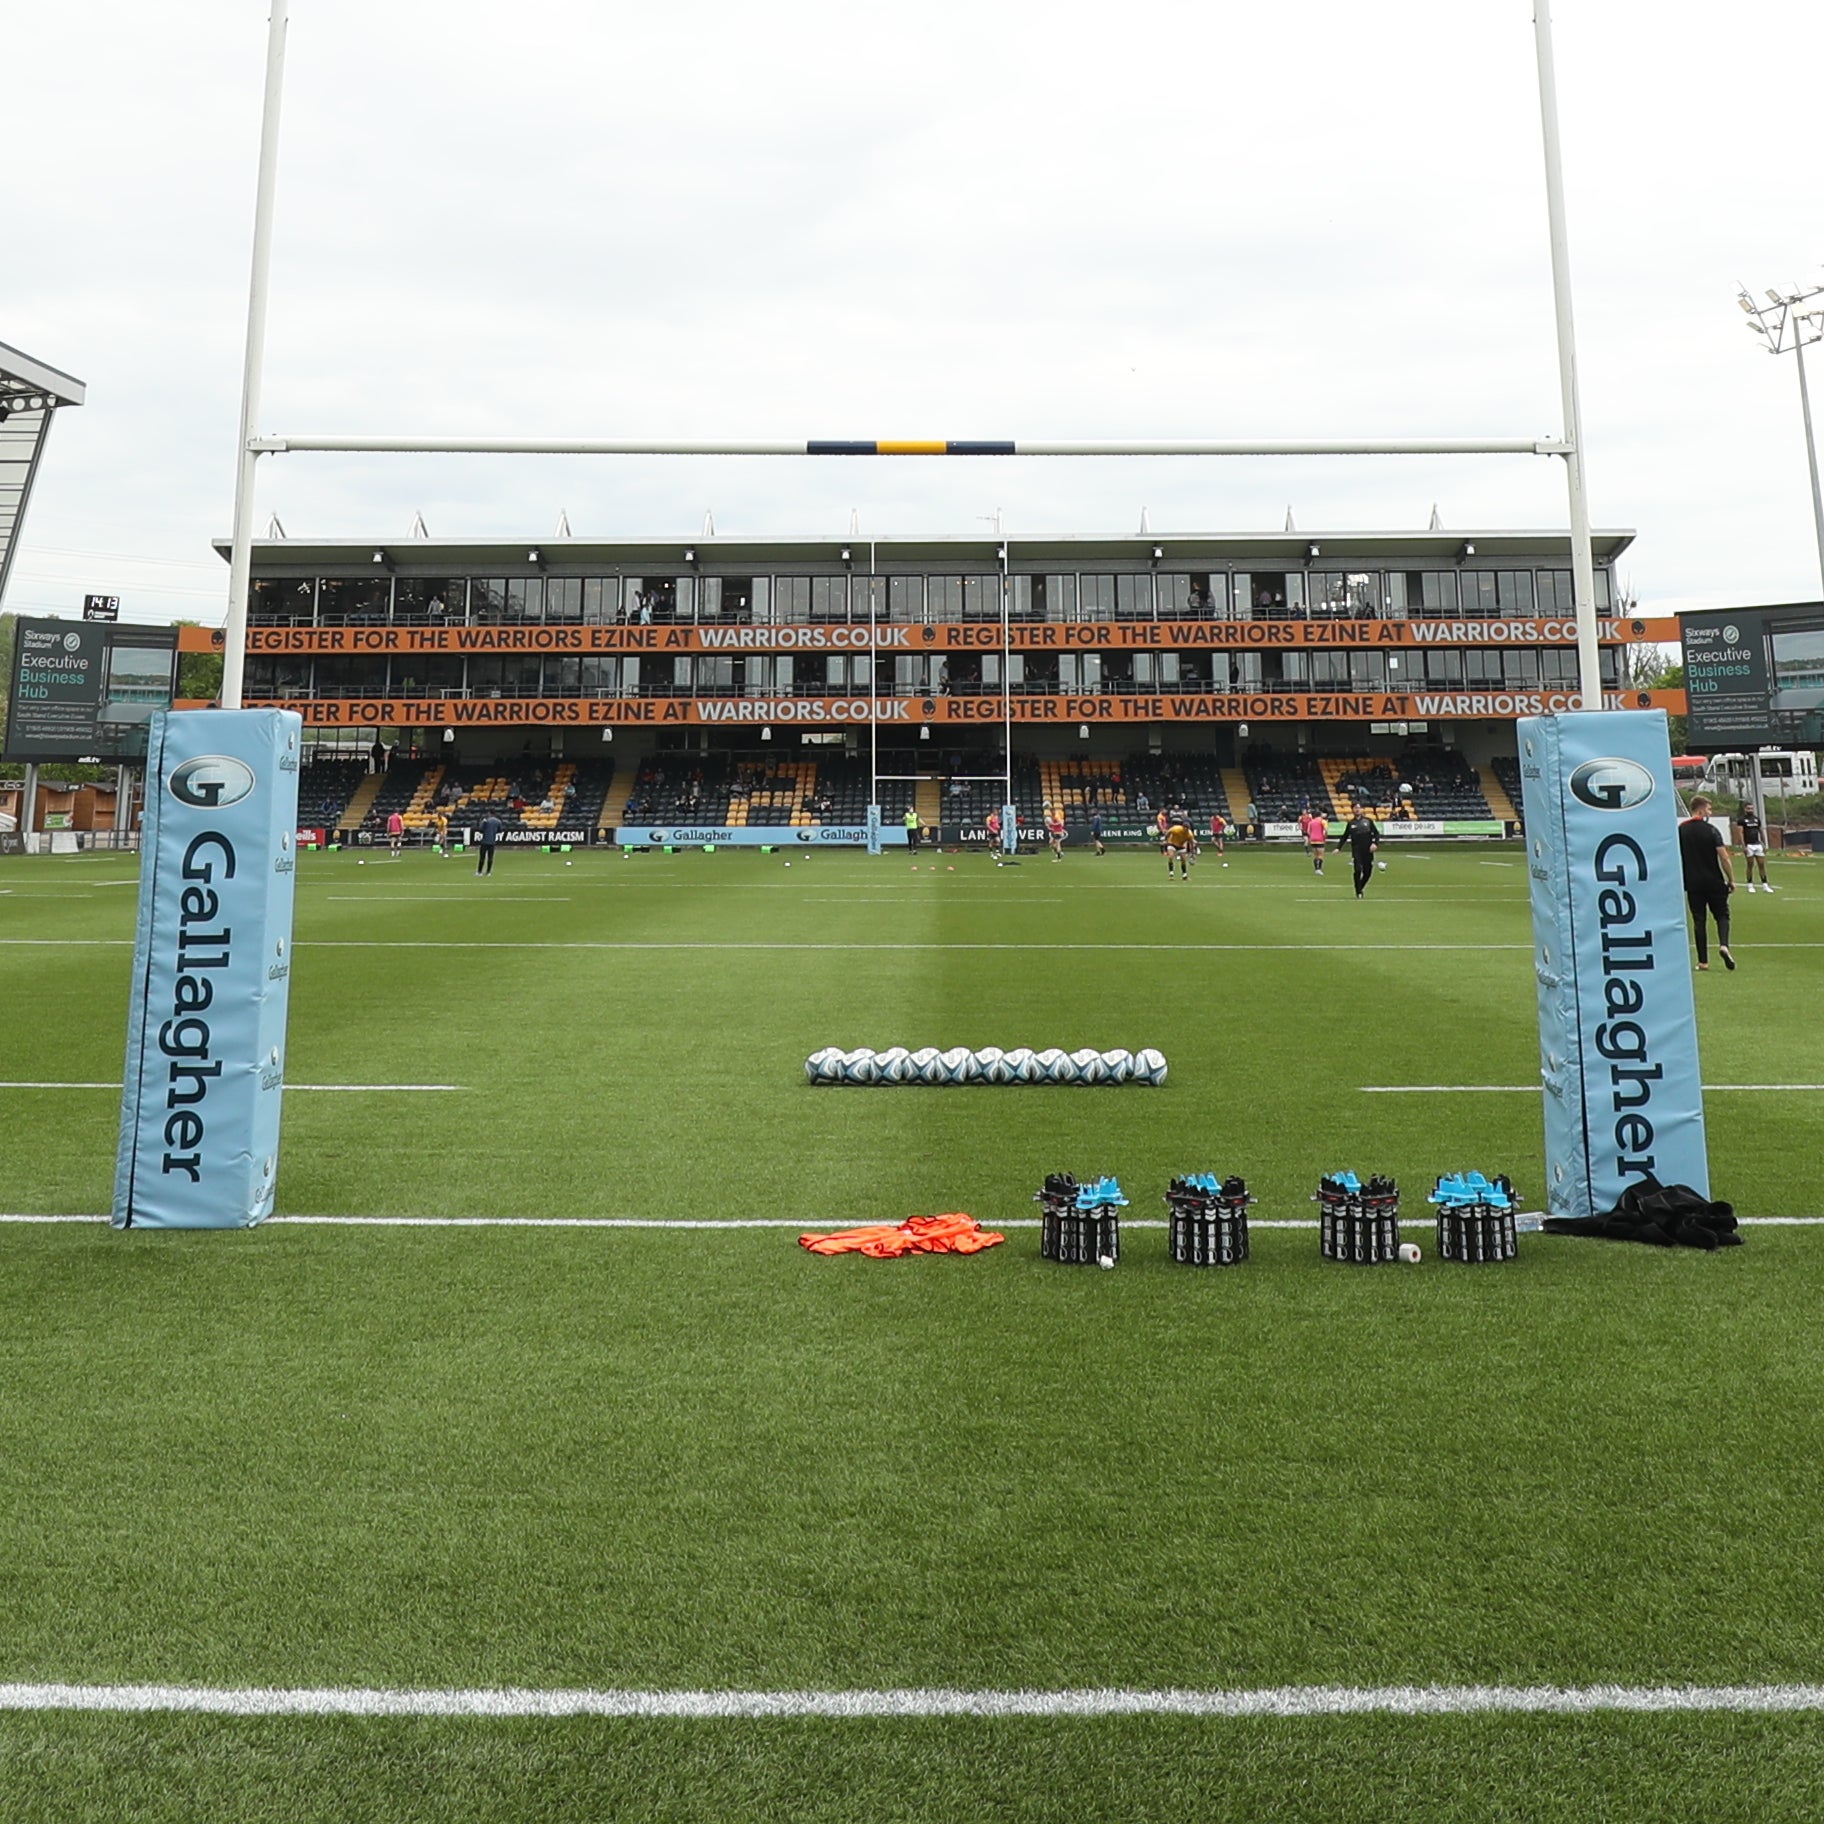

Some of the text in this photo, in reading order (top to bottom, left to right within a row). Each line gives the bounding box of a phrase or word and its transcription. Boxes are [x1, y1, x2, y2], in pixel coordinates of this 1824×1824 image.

[24, 630, 61, 643] Sixways
[246, 627, 910, 650] EGISTER FOR THE WARRIORS EZINE AT WARRIORS.CO.UK
[947, 621, 1622, 646] REGISTER FOR THE WARRIORS EZINE AT WARRIORS.COUK
[1685, 627, 1720, 638] Sixways
[24, 640, 52, 649] Stadium
[1686, 637, 1713, 645] Stadium
[21, 653, 89, 670] Executive
[1686, 647, 1752, 663] Executive
[20, 669, 85, 685] Business
[1688, 663, 1751, 678] Business
[18, 686, 48, 699] Hub
[1690, 679, 1718, 693] Hub
[348, 702, 395, 722] FOR
[398, 702, 445, 721] THE
[451, 701, 580, 722] WARRIORS
[588, 702, 656, 721] EZINE
[662, 702, 692, 721] AT
[696, 700, 910, 721] WARRIORS.CO.UK
[947, 698, 1059, 719] REGISTER
[1066, 698, 1114, 718] FOR
[1119, 698, 1164, 717] THE
[1170, 697, 1299, 717] WARRIORS
[1307, 696, 1375, 717] EZINE
[1381, 696, 1410, 716] AT
[505, 832, 544, 842] AGAINST
[547, 831, 584, 841] RACISM
[673, 829, 732, 843] Gallagher
[960, 829, 988, 841] LAN
[1099, 829, 1142, 837] EENE KING
[159, 829, 237, 1184] Gallagher
[1594, 832, 1663, 1178] Gallagher
